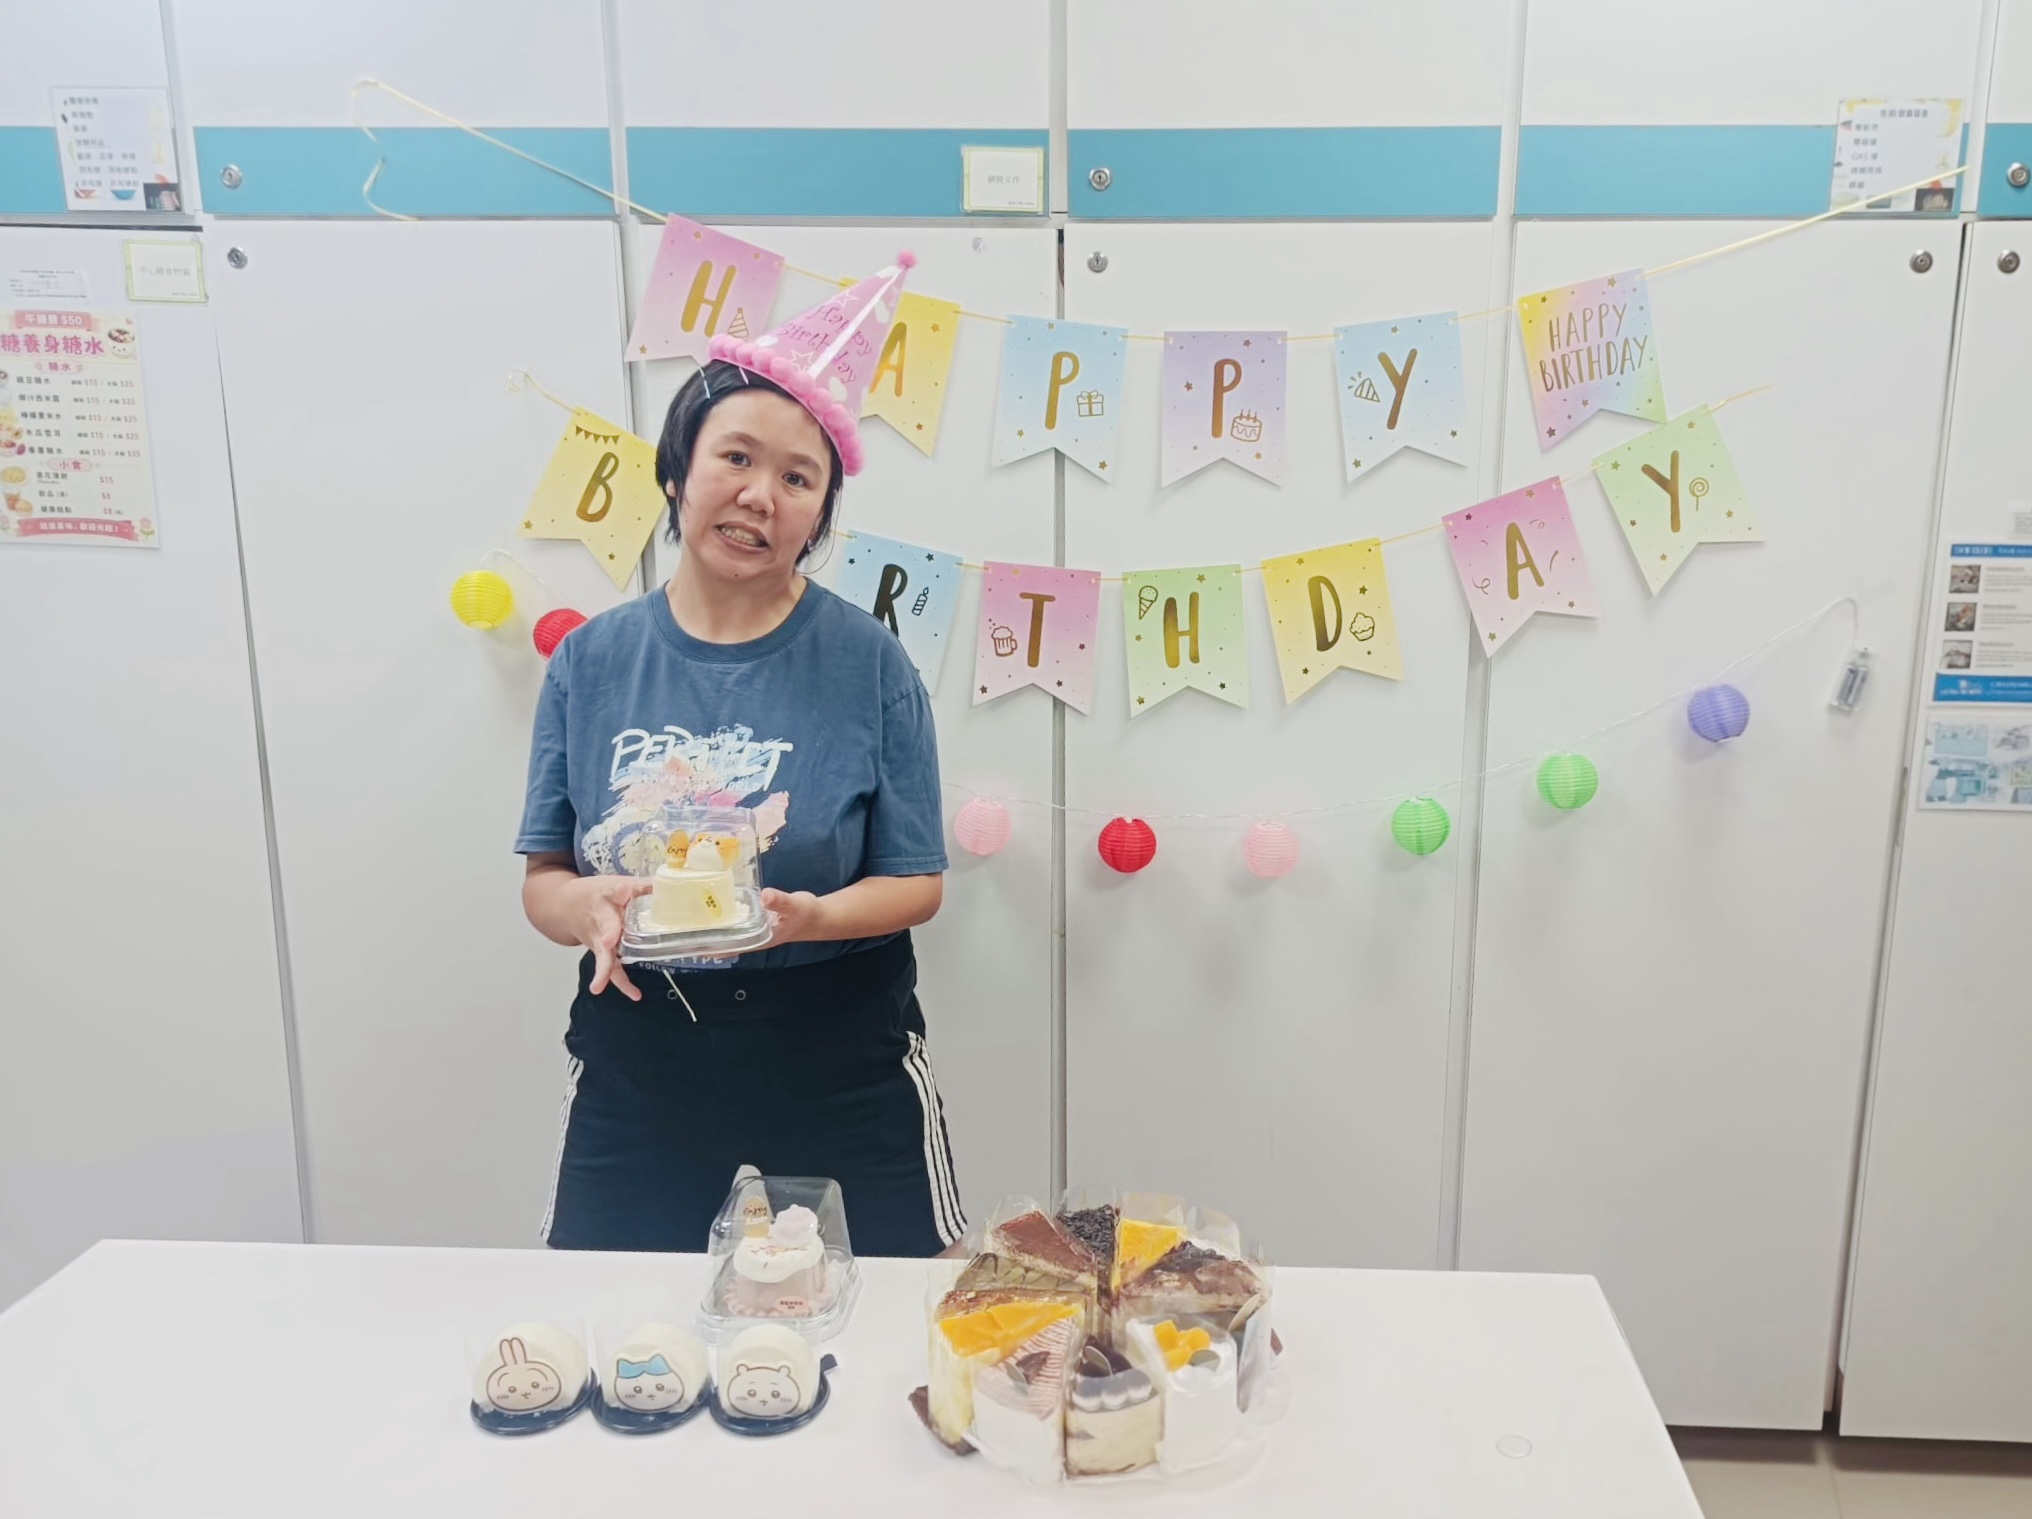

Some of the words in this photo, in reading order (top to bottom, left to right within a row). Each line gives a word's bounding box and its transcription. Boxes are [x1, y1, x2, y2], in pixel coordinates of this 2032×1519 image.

[61, 315, 82, 325] $50
[1549, 303, 1627, 352] HAPPY
[680, 260, 737, 338] H
[868, 322, 907, 397] A
[1045, 351, 1100, 430] P
[1211, 358, 1242, 439] P
[1378, 348, 1418, 430] Y
[1540, 335, 1648, 392] BIRTHDAY
[59, 460, 82, 470] 小食
[576, 452, 619, 522] B
[873, 563, 908, 637] R
[1019, 592, 1056, 668] T
[1163, 591, 1200, 668] H
[1308, 575, 1343, 652] D
[1506, 522, 1545, 600] A
[1641, 450, 1681, 533] Y
